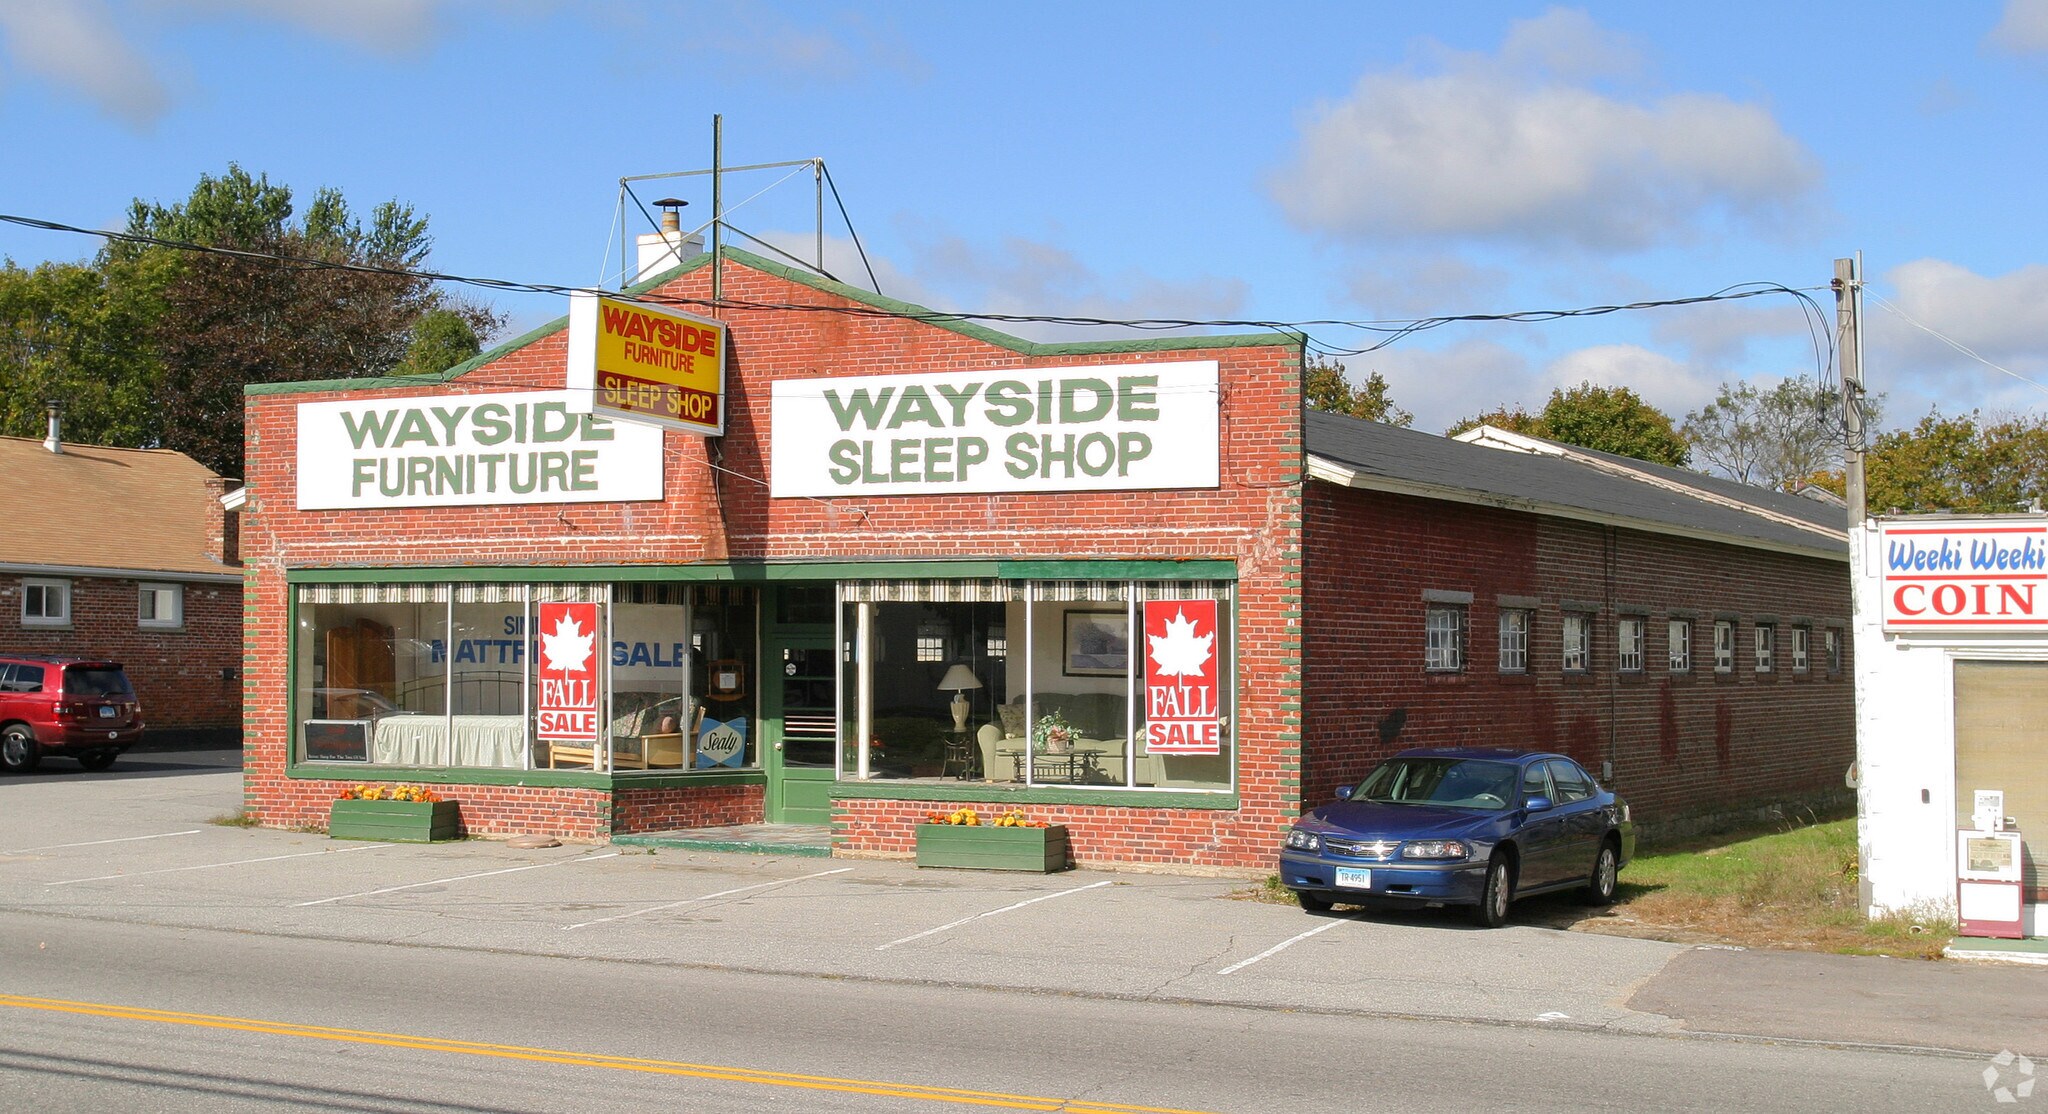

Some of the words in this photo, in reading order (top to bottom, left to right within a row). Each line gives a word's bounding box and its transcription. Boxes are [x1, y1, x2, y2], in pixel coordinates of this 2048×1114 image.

[602, 305, 716, 358] WAYSIDE
[624, 341, 695, 374] FURNITURE
[604, 376, 662, 411] SLEEP
[666, 388, 713, 419] SHOP
[823, 375, 1160, 431] WAYSIDE
[340, 401, 615, 450] WAYSIDE
[352, 450, 599, 497] FURNITURE
[829, 436, 989, 485] SLEEP
[1004, 432, 1153, 480] SHOP
[1888, 537, 1962, 571] Weeki
[1970, 536, 2046, 570] Weeki
[1893, 584, 2038, 616] COIN
[540, 678, 596, 708] FALL
[1149, 685, 1217, 717] FALL
[540, 712, 596, 732] SALE
[1149, 723, 1218, 746] SALE
[703, 732, 738, 754] Sealy
